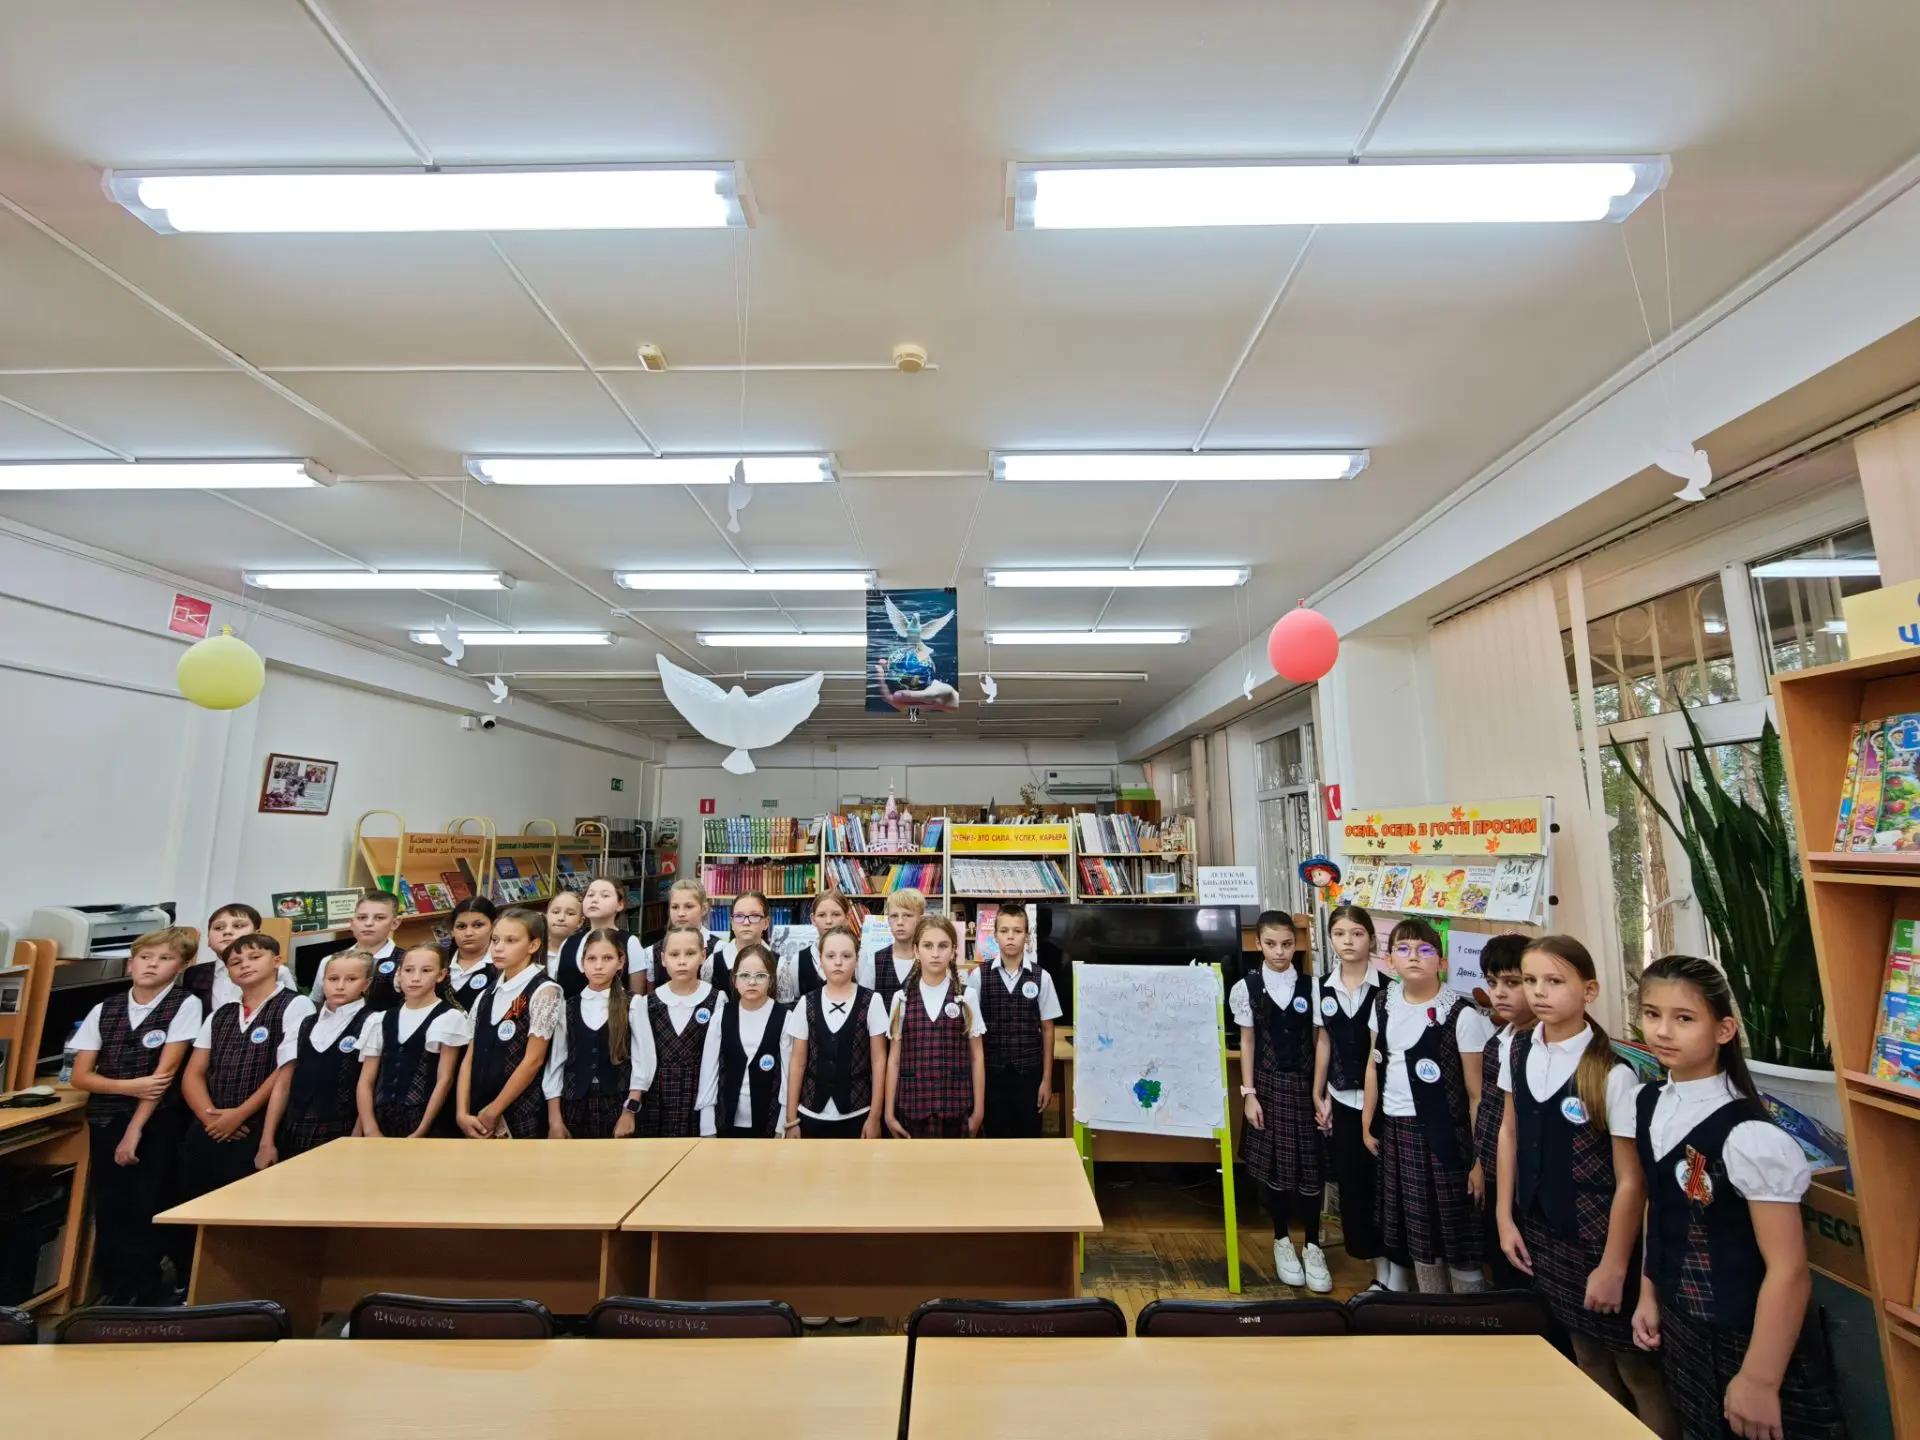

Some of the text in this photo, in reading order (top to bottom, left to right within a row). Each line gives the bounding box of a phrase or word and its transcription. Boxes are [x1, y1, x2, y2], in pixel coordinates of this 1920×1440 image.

[1382, 823, 1416, 838] ОСЕНЬ
[1430, 820, 1471, 838] ГОСТИ
[1040, 832, 1067, 841] КАРЬЕРА
[1211, 871, 1244, 879] ДЕТСКАЯ
[1456, 967, 1477, 978] День
